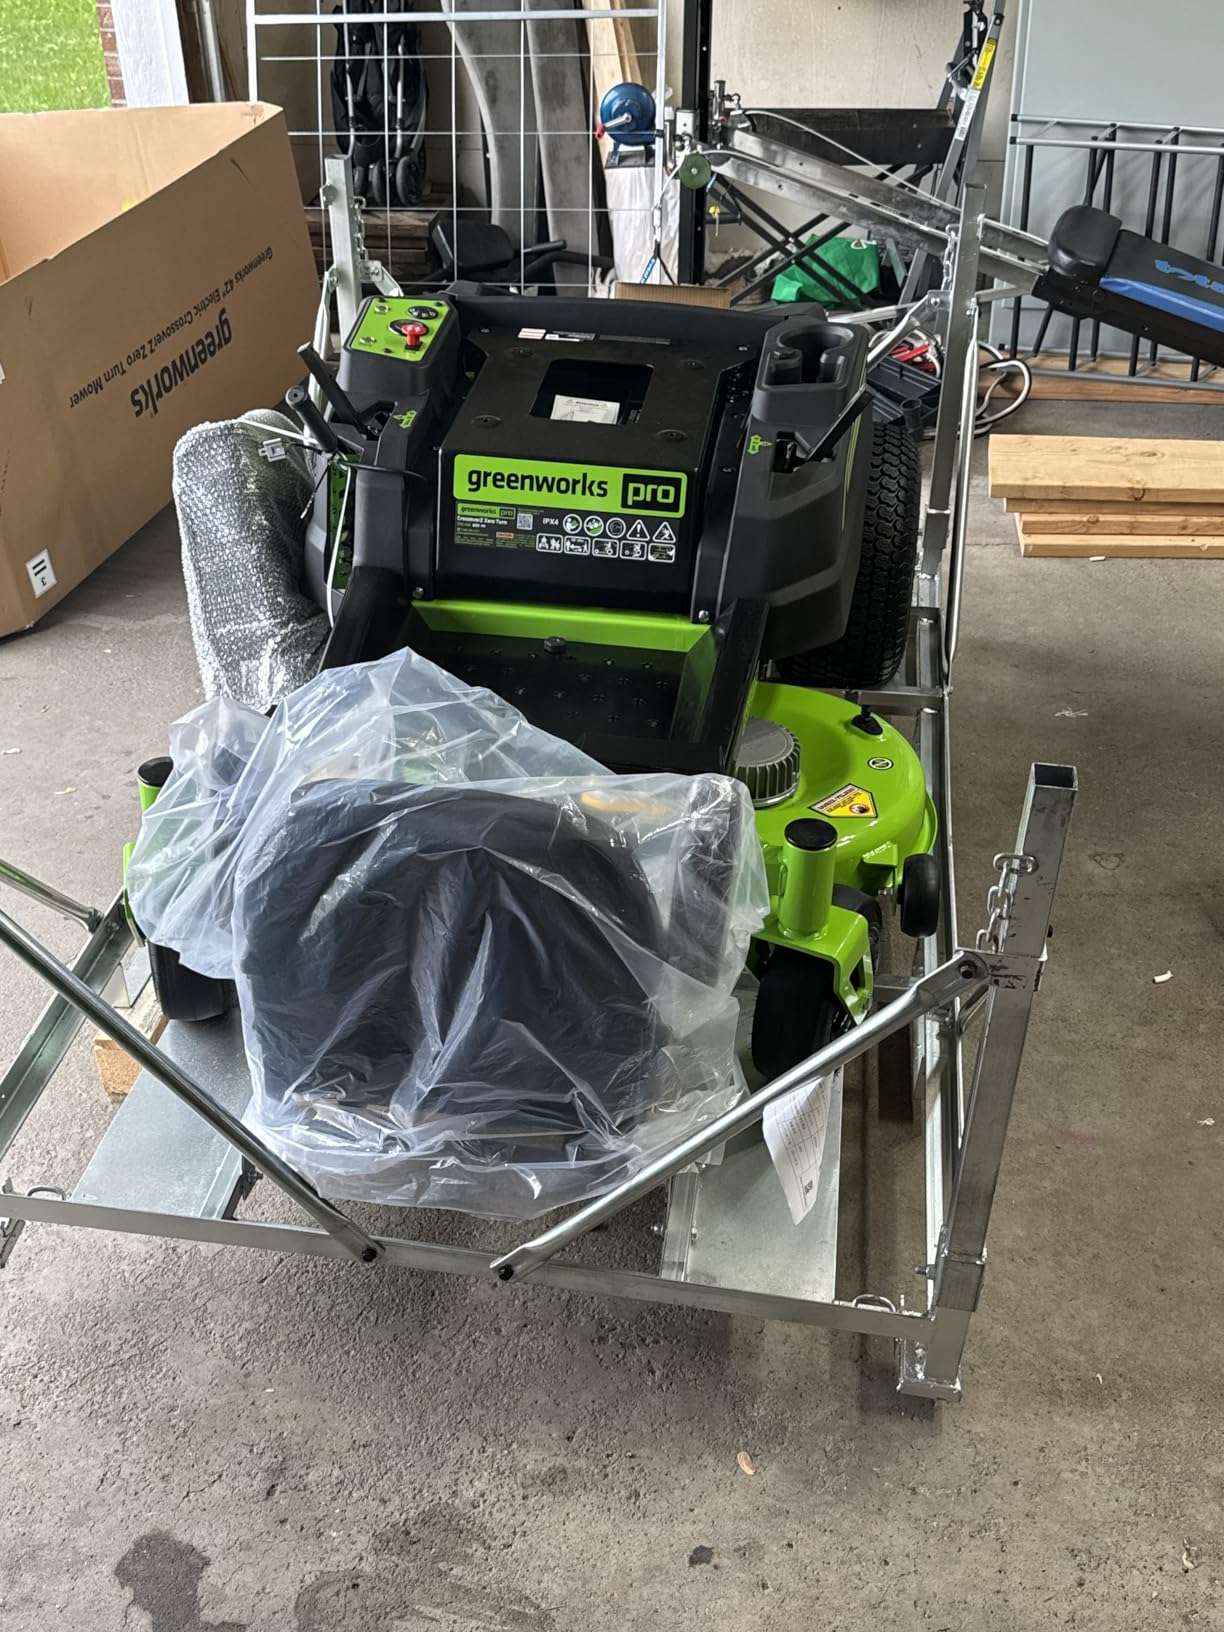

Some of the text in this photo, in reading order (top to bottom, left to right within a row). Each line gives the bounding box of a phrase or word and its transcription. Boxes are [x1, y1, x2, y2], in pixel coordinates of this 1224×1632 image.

[234, 247, 273, 282] Greenworks
[193, 287, 222, 317] Electric
[147, 310, 194, 354] CrossoverZ
[103, 360, 128, 383] Turn
[126, 344, 149, 366] Zero
[130, 307, 232, 417] greenworks
[69, 376, 104, 409] Mower
[467, 468, 676, 506] greenworks pro
[542, 517, 559, 525] IPX4
